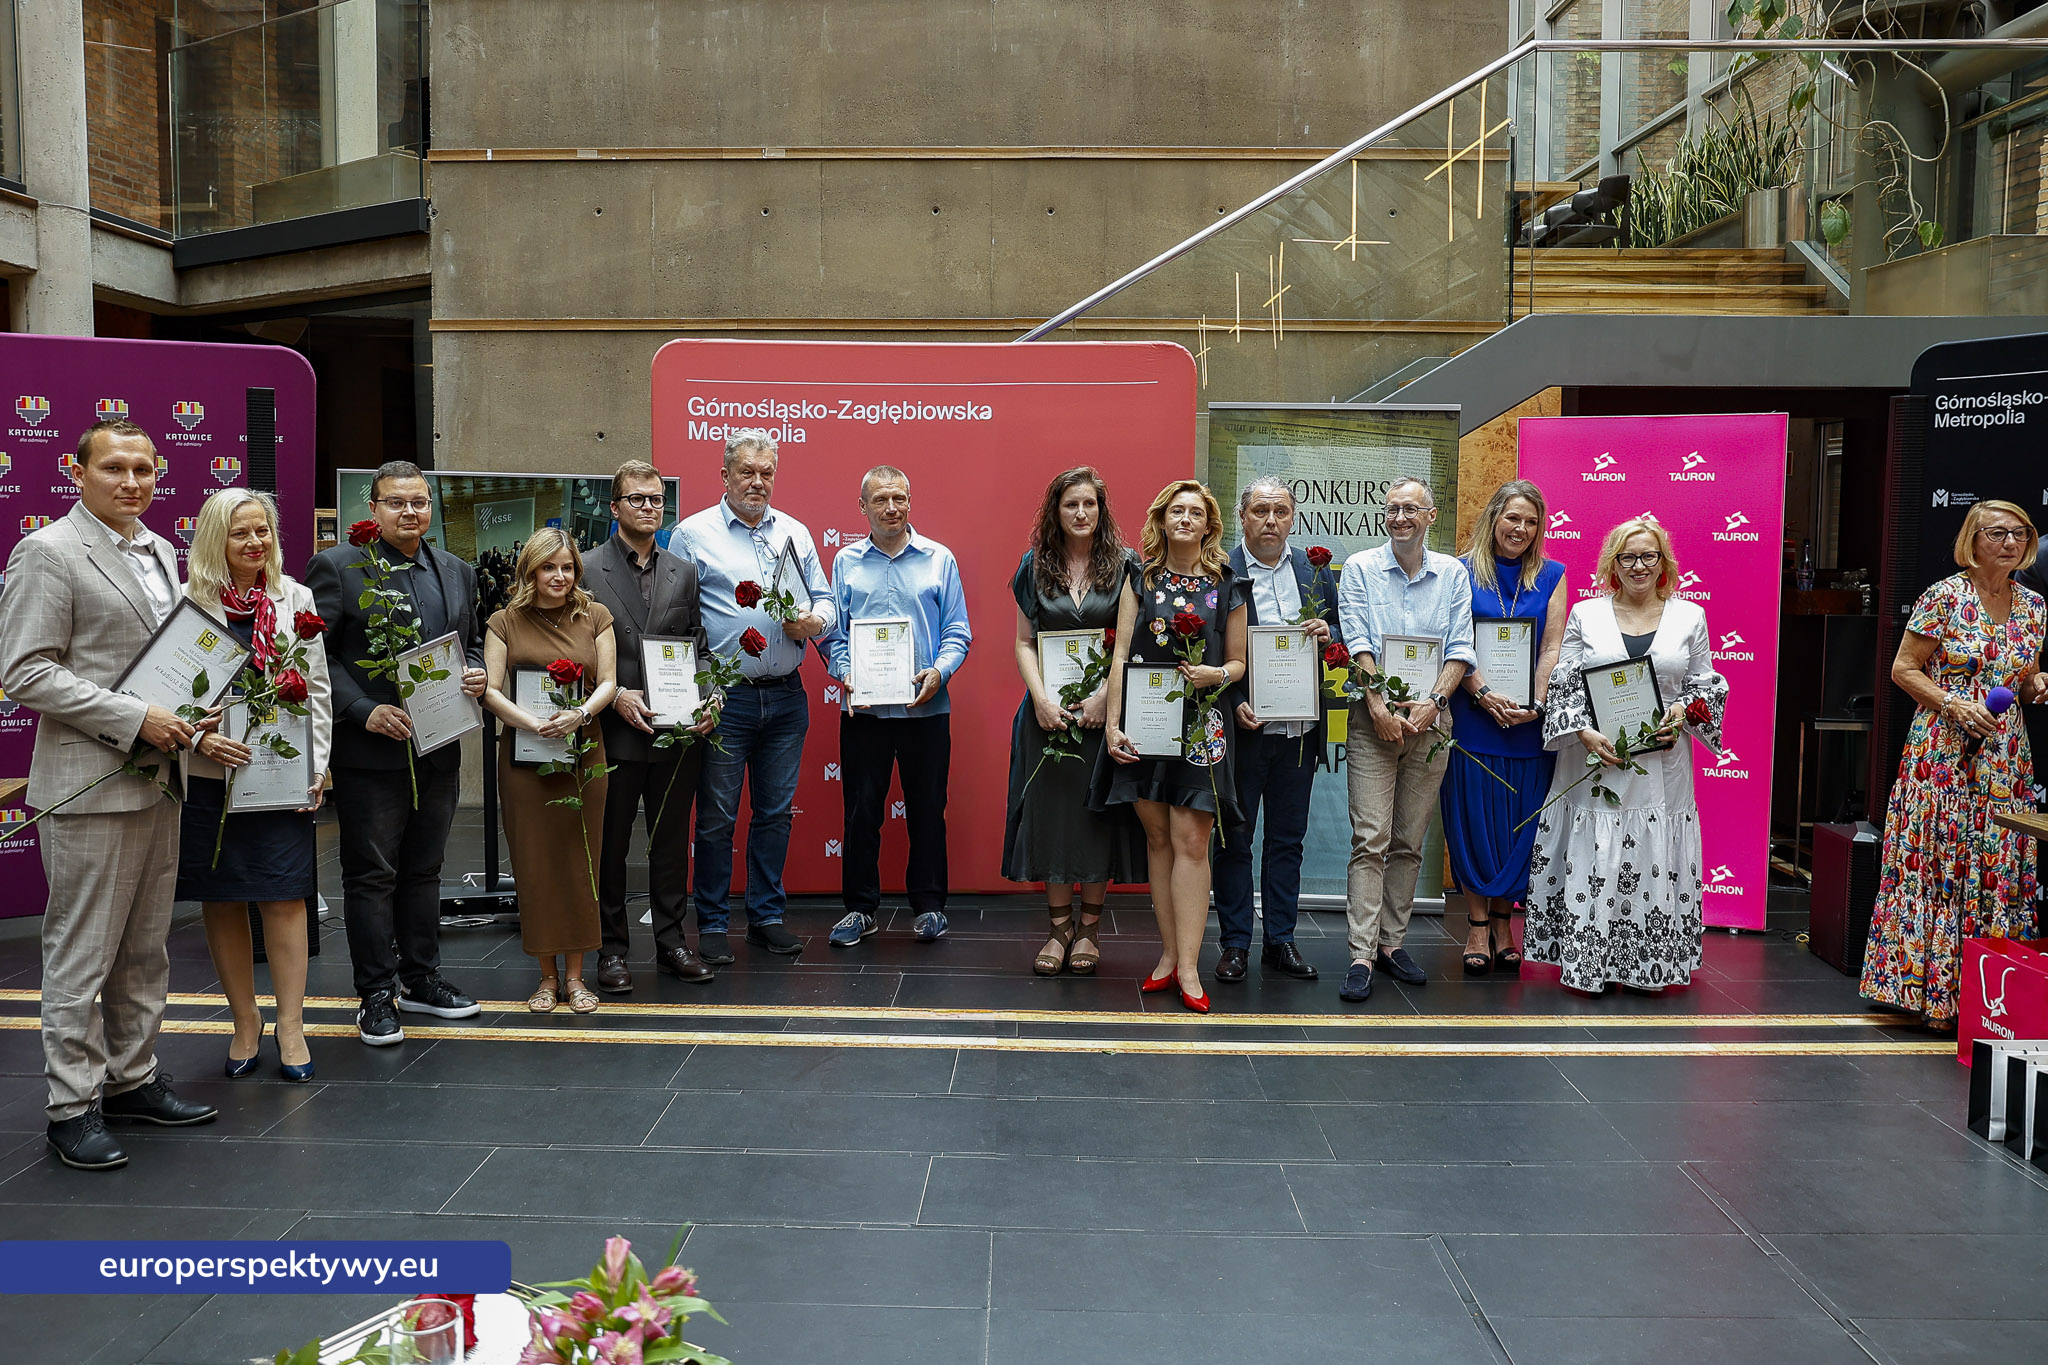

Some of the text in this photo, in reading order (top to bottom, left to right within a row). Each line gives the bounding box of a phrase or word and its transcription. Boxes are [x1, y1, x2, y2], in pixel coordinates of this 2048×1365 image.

[687, 396, 993, 425] Górnośląsko-Zagłębiowska
[1934, 409, 2026, 429] Metropolia
[8, 428, 59, 438] KATOWICE
[166, 432, 213, 442] KATOWICE
[1580, 472, 1626, 482] TAURON
[1669, 472, 1715, 482] TAURON
[51, 486, 82, 494] KATOW
[153, 487, 176, 496] WICE
[1288, 480, 1391, 506] ONKURS
[491, 513, 512, 525] KSSE
[1289, 511, 1388, 537] NNIKAR
[1544, 530, 1581, 540] AURON
[1712, 532, 1759, 542] TAURON
[1578, 588, 1605, 598] TAUR
[1671, 591, 1711, 601] AURON
[1709, 650, 1754, 661] TAURON
[0, 718, 33, 727] OWICE
[1702, 767, 1749, 779] TAURON
[1701, 883, 1744, 896] AURON
[1981, 1015, 2015, 1040] TAURON
